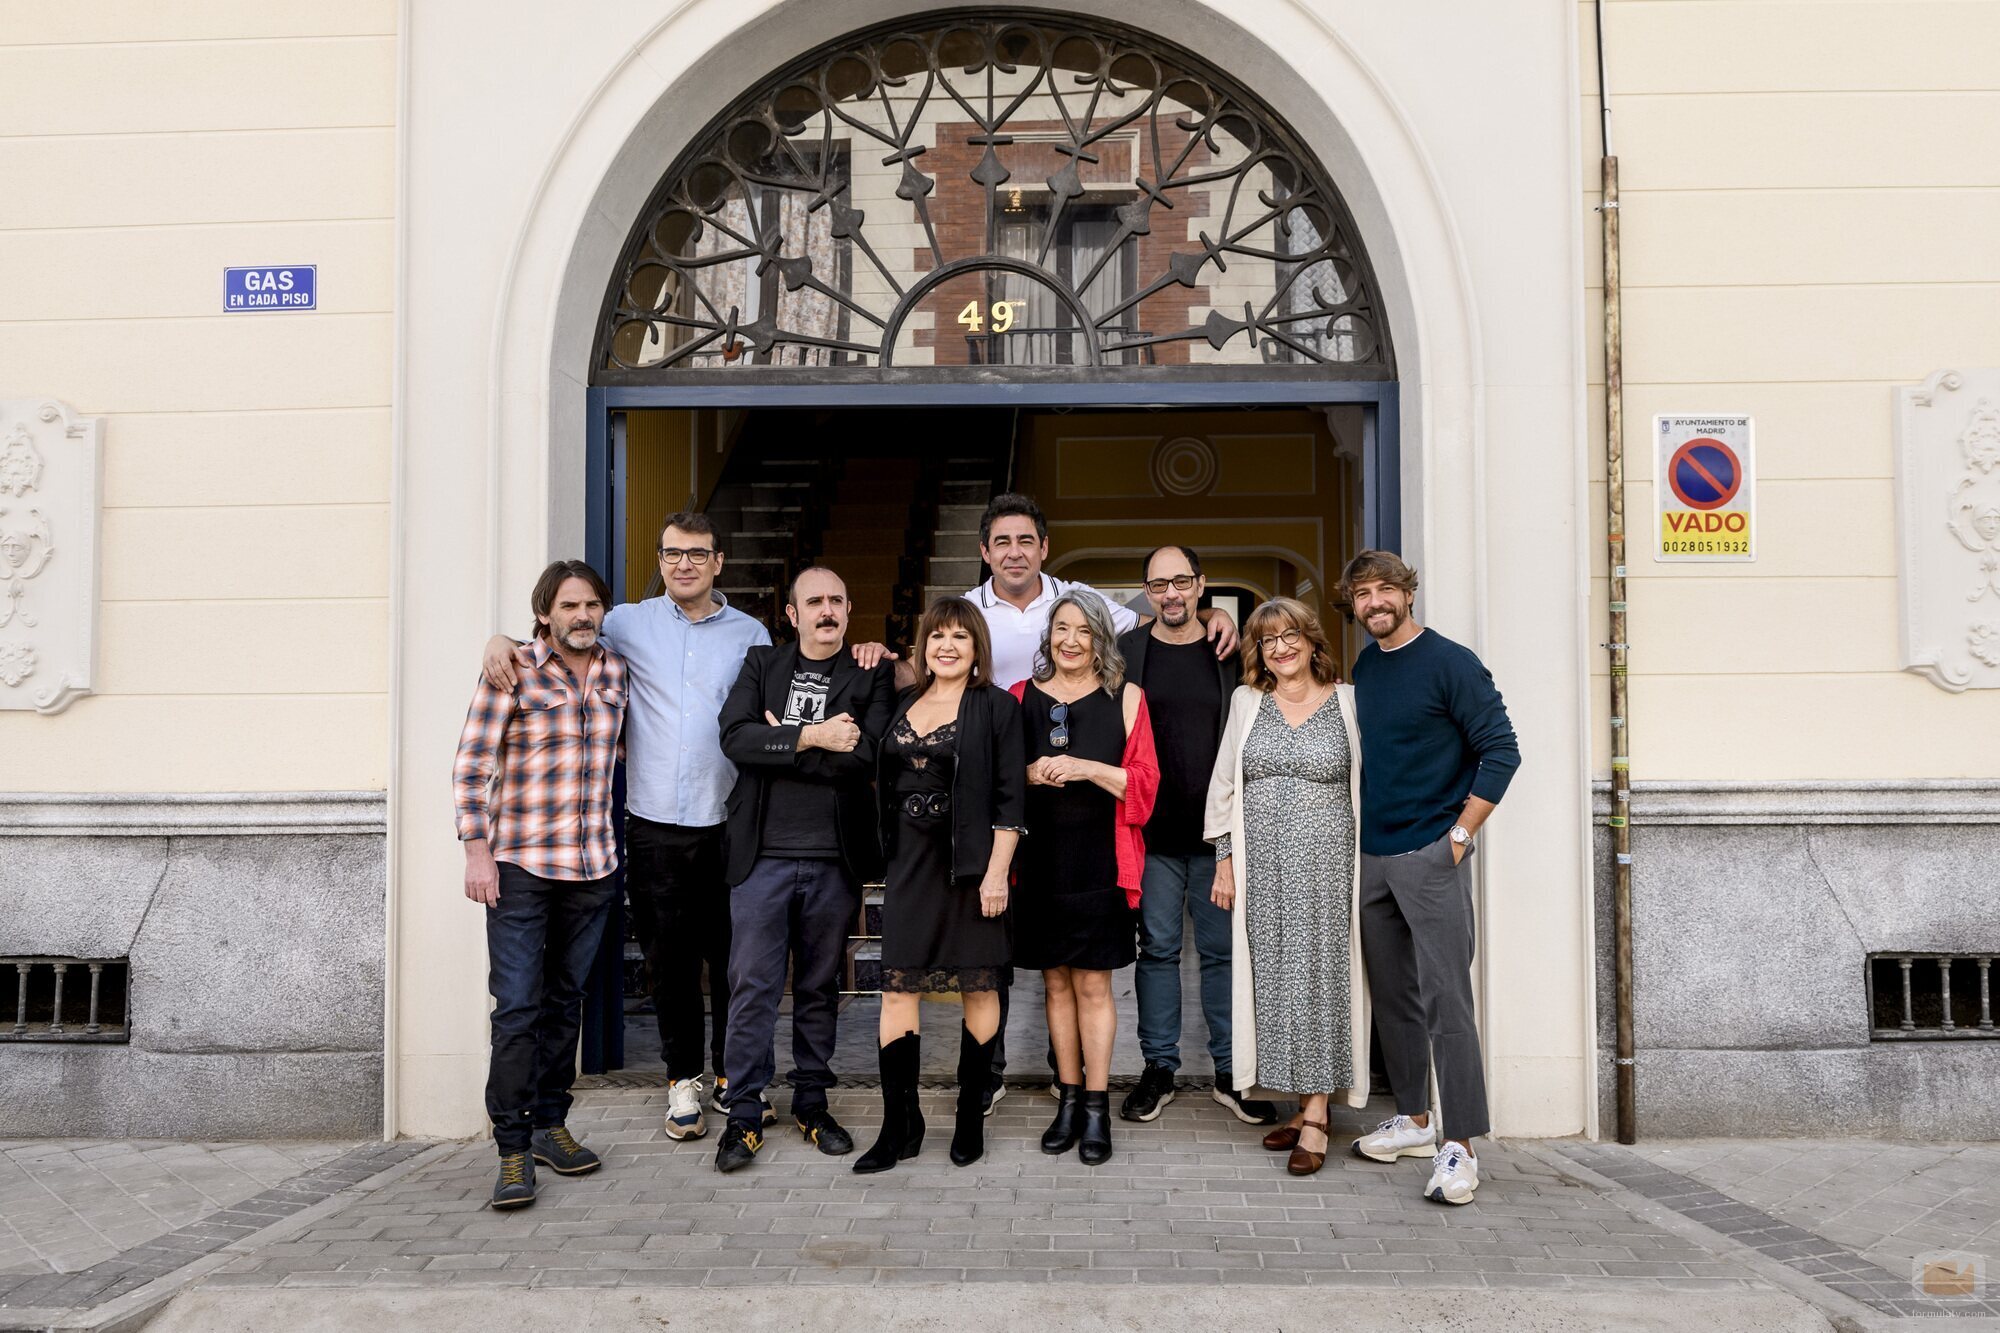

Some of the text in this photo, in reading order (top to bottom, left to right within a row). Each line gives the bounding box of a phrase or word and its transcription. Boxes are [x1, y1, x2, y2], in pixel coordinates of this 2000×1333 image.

[244, 270, 294, 291] GAS
[230, 292, 309, 306] EN CADA PISO
[957, 300, 1014, 333] 49
[1666, 512, 1746, 533] VADO
[1663, 541, 1748, 553] 0028051932
